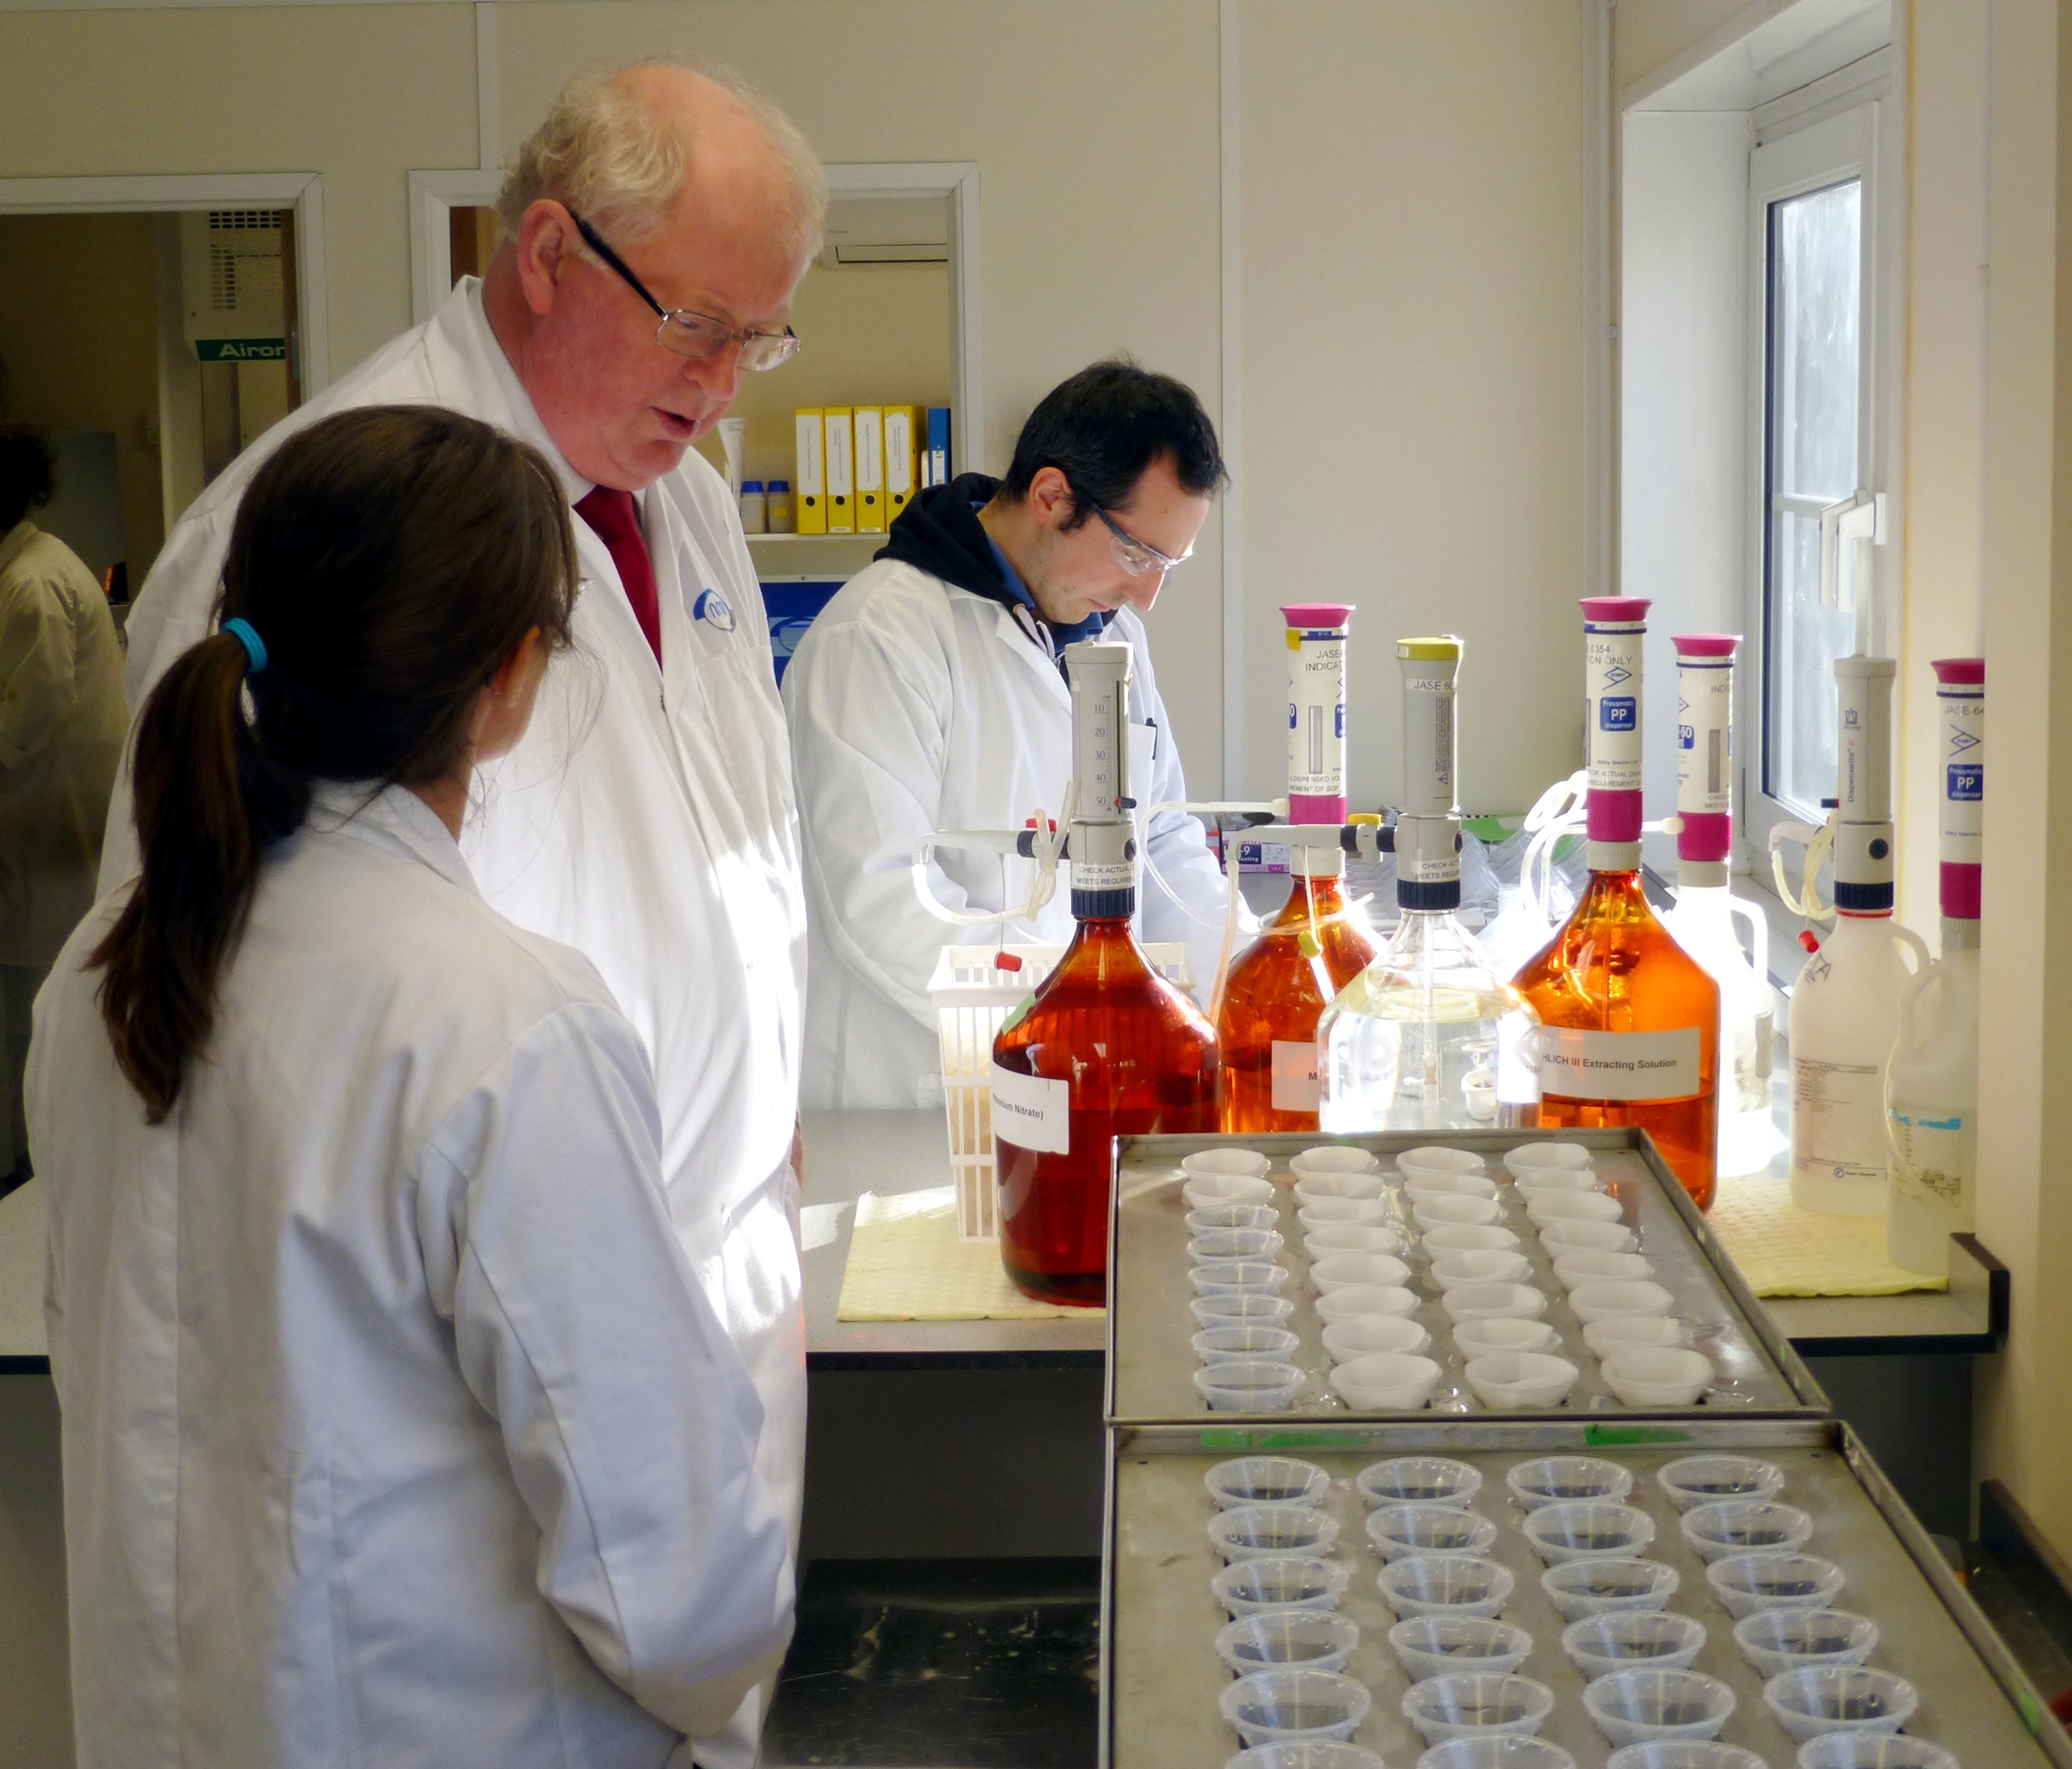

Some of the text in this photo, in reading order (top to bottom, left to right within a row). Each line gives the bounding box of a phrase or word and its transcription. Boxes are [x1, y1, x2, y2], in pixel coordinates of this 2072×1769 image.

[1604, 656, 1632, 665] ONLY
[1414, 680, 1442, 691] JASE
[1094, 703, 1105, 713] 10
[1611, 708, 1627, 721] PP
[1094, 727, 1106, 736] 20
[1095, 750, 1106, 759] 30
[1095, 773, 1107, 782] 40
[1957, 776, 1975, 790] PP
[1096, 796, 1107, 805] 50
[1105, 865, 1131, 874] ACTUAL
[1422, 861, 1448, 869] CHECK
[1076, 876, 1099, 885] MEETS
[1570, 1056, 1580, 1066] III
[1582, 1058, 1636, 1071] Extracting
[1637, 1058, 1677, 1070] Solution
[1014, 1103, 1044, 1121] Nitrate)
